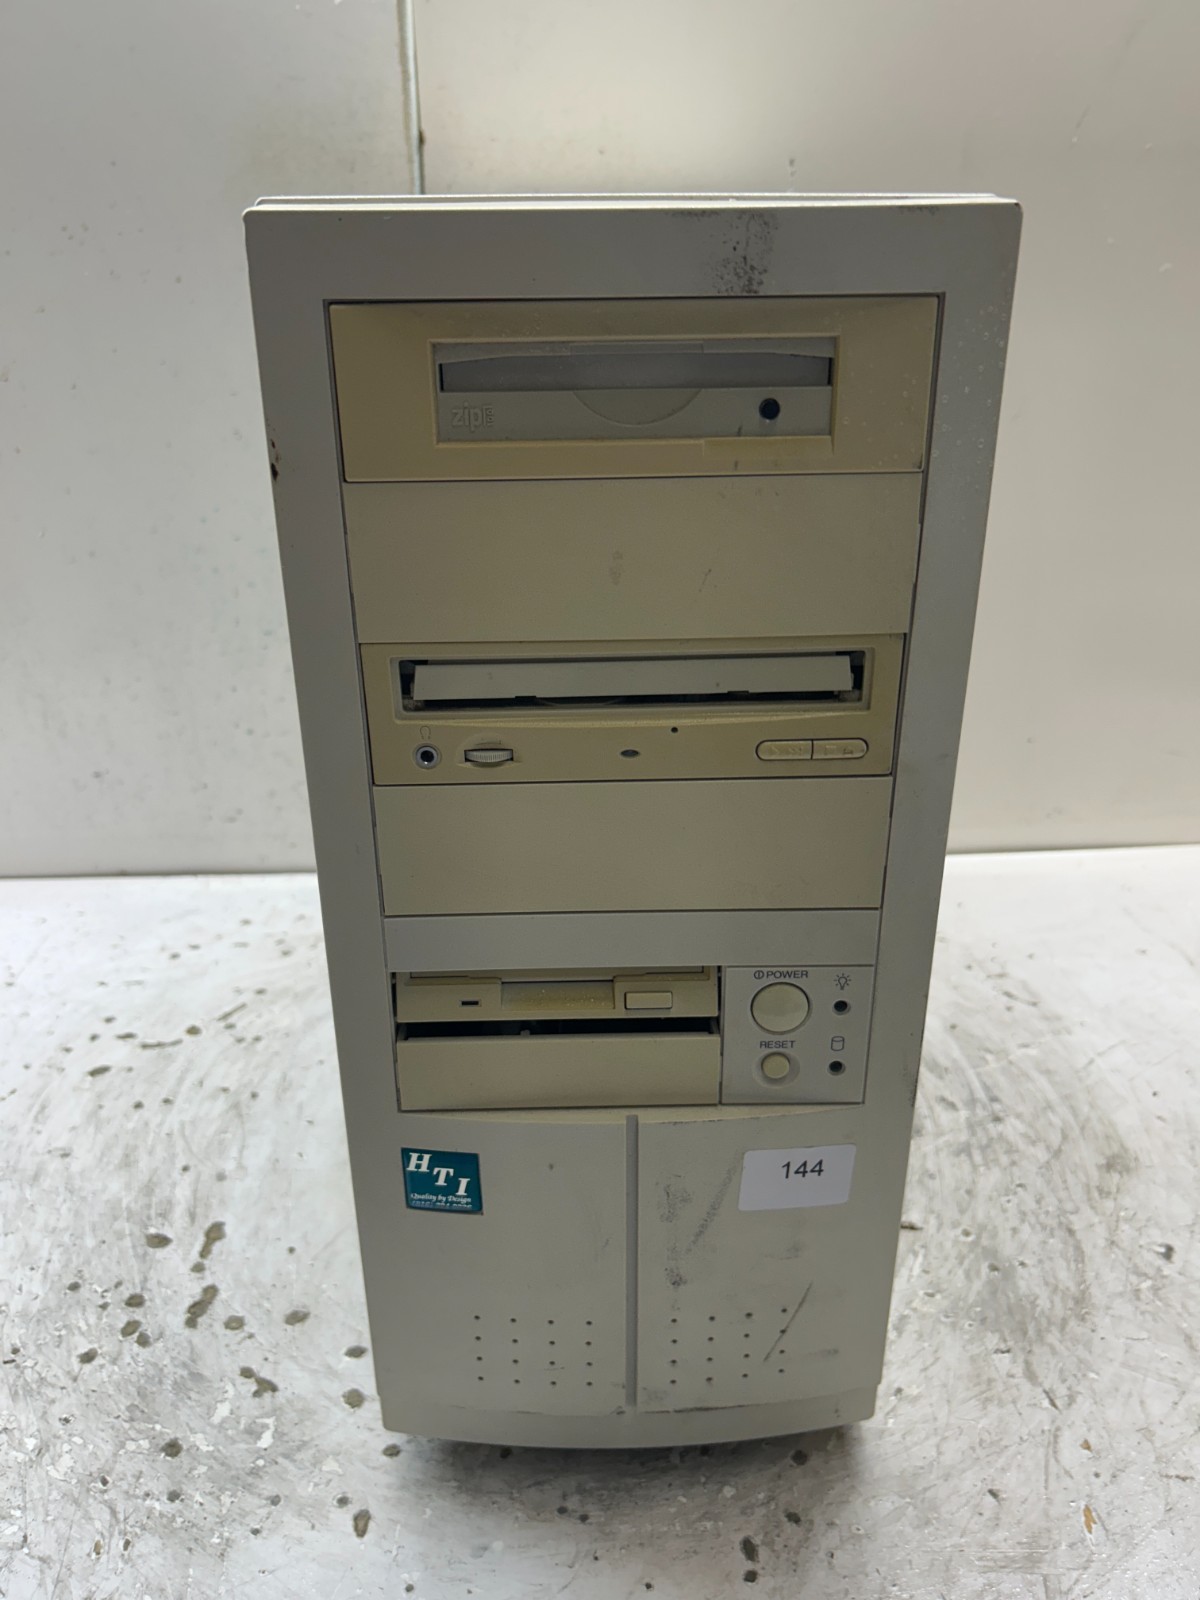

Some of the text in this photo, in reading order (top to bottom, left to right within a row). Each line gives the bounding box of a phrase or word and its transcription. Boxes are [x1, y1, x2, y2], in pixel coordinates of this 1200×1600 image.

[451, 401, 483, 432] zip
[766, 969, 809, 979] POWER
[759, 1040, 796, 1049] RESET
[406, 1152, 471, 1196] HTI
[781, 1159, 824, 1179] 144
[410, 1192, 472, 1204] Quality by Design
